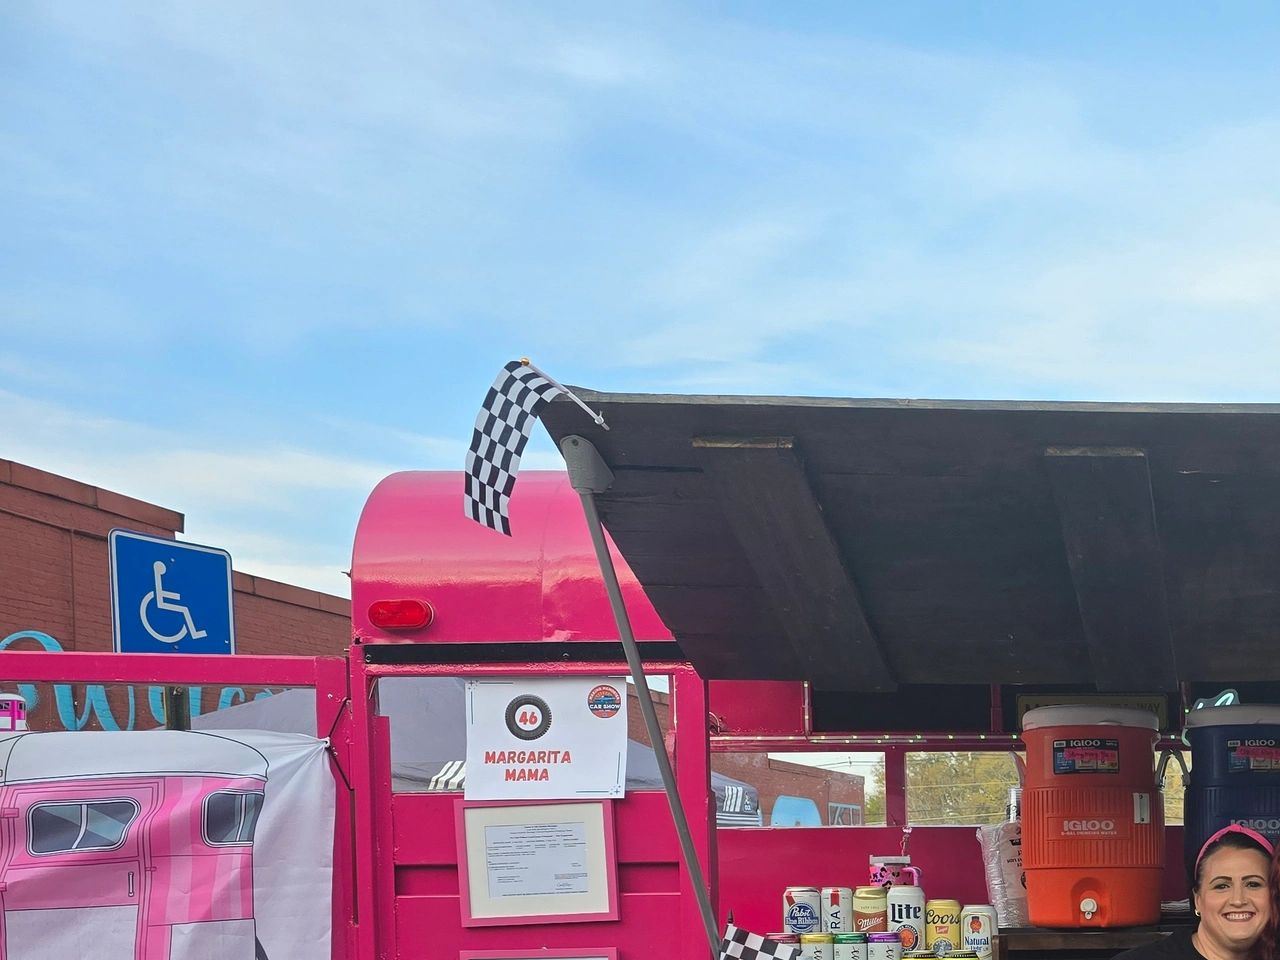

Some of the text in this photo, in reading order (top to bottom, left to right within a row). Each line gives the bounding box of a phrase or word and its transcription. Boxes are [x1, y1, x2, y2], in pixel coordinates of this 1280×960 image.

[518, 711, 539, 726] 46
[484, 750, 572, 764] MARGARITA
[504, 768, 550, 781] MAMA
[1063, 820, 1114, 831] IGLOO
[1230, 819, 1280, 830] IGLOO
[791, 906, 811, 918] Pabst
[890, 903, 922, 923] Lite
[926, 909, 960, 925] Coors
[858, 917, 884, 931] Miller
[964, 936, 989, 946] Natural
